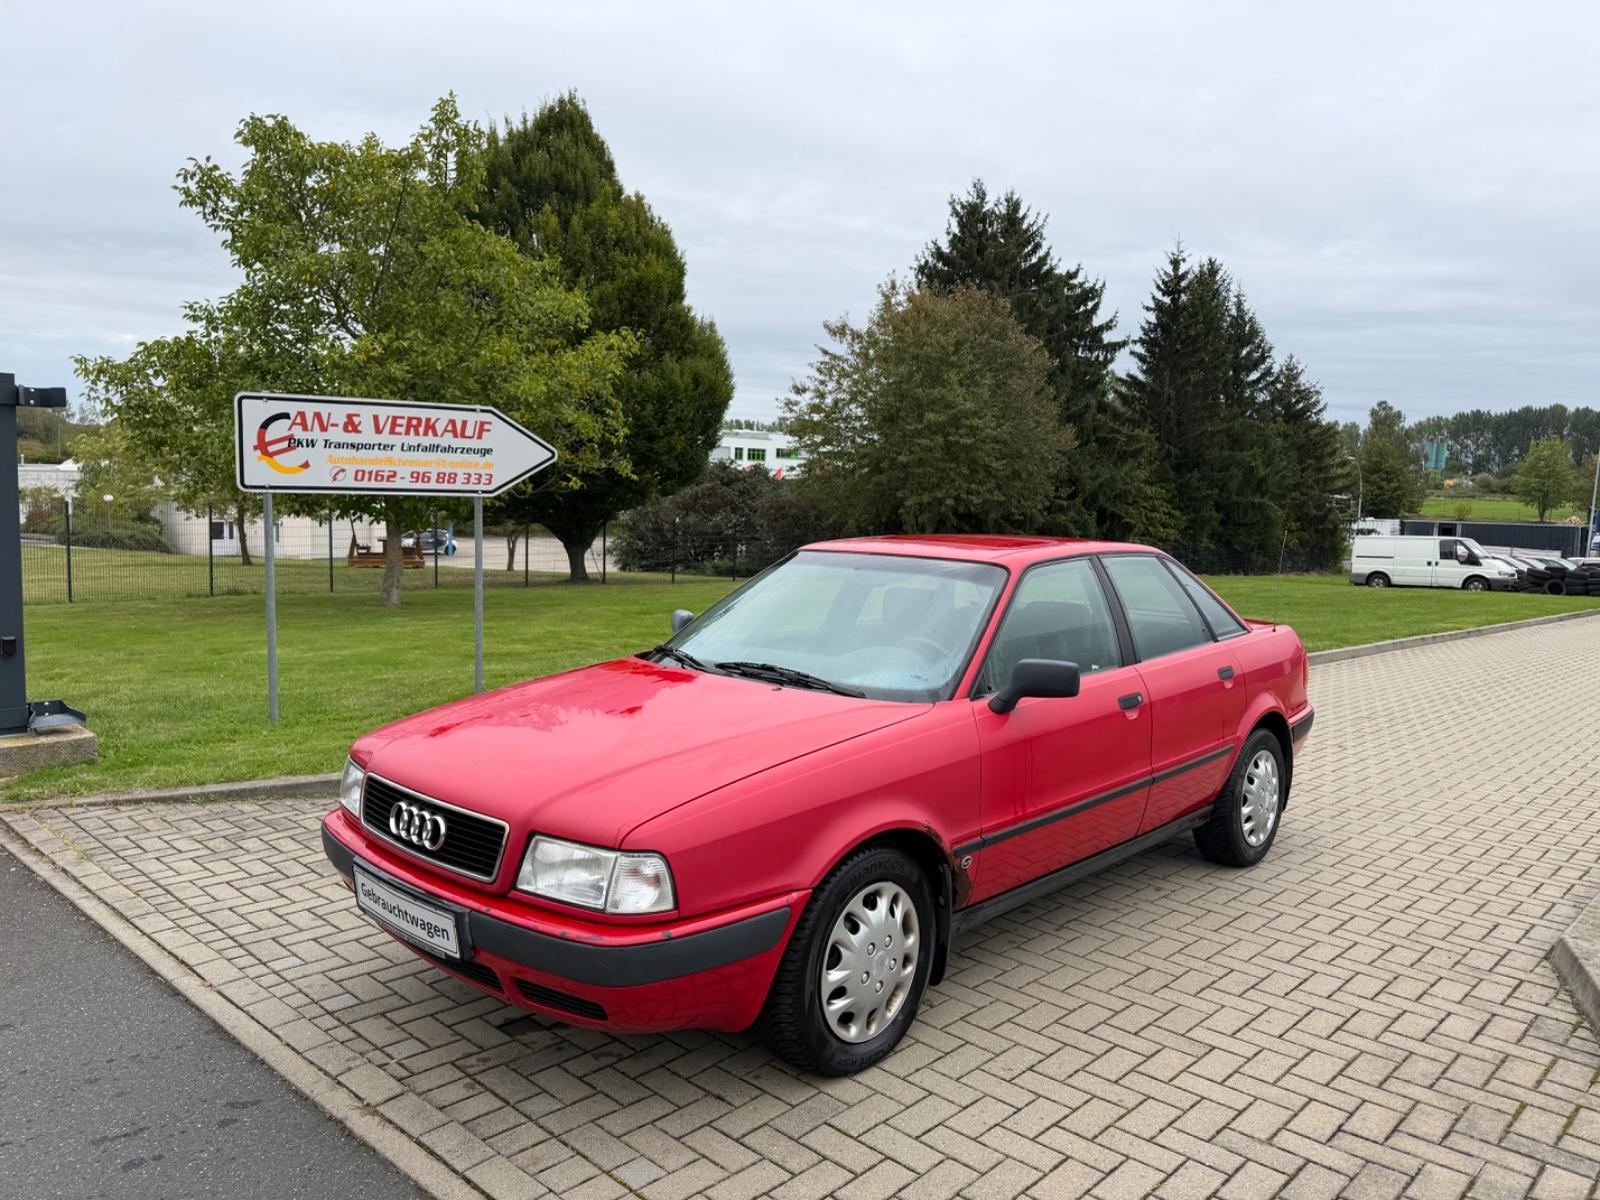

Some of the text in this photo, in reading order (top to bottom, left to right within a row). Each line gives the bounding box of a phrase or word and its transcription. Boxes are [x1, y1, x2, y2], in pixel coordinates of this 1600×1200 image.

[372, 414, 493, 440] VERKAUF
[287, 438, 493, 457] PKW Transporter Unfallfahrzeuge
[354, 468, 397, 483] 0162
[435, 472, 458, 485] 88
[461, 473, 493, 486] 333
[361, 883, 450, 941] Gebrauchtwagen
